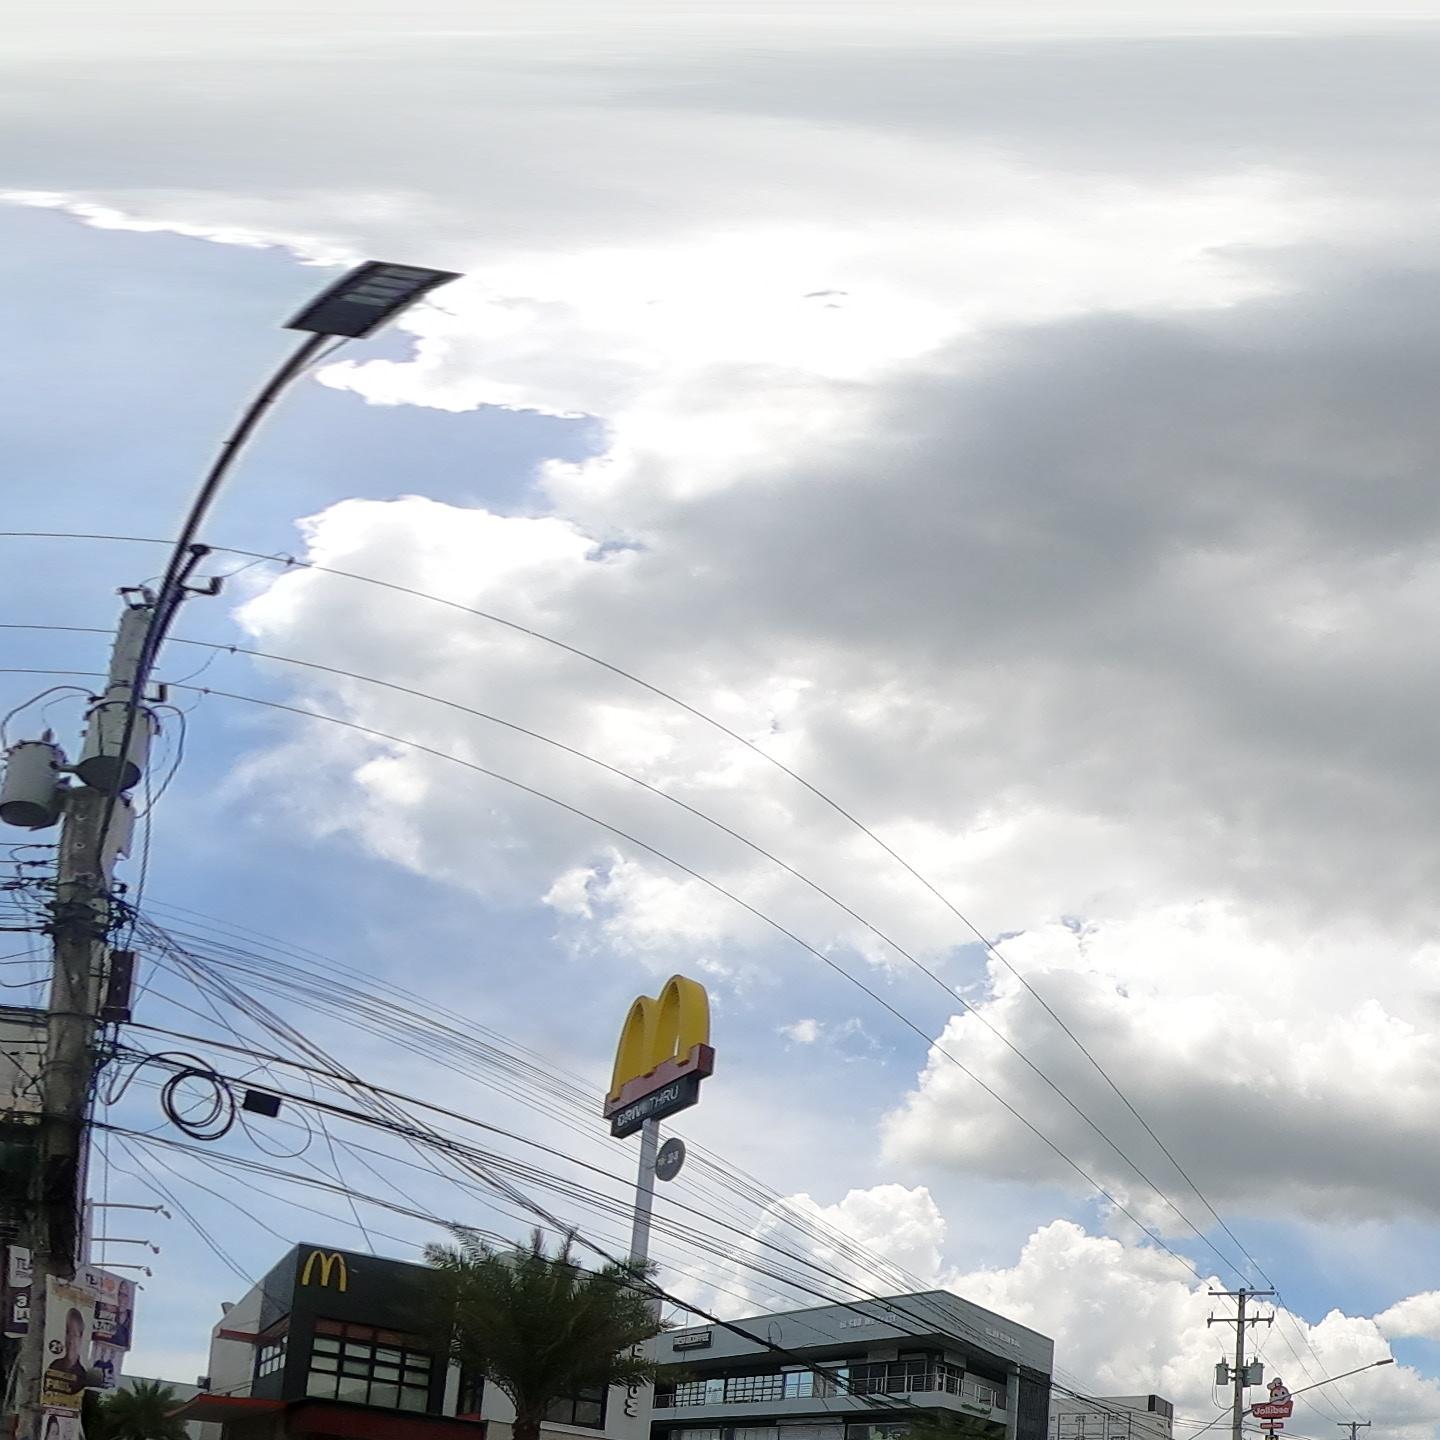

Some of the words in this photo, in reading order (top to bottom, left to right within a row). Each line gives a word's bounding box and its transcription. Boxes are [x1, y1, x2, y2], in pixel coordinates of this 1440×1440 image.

[617, 1100, 650, 1127] DRIV
[650, 1085, 680, 1108] THRU
[1253, 1406, 1290, 1416] Jollibee
